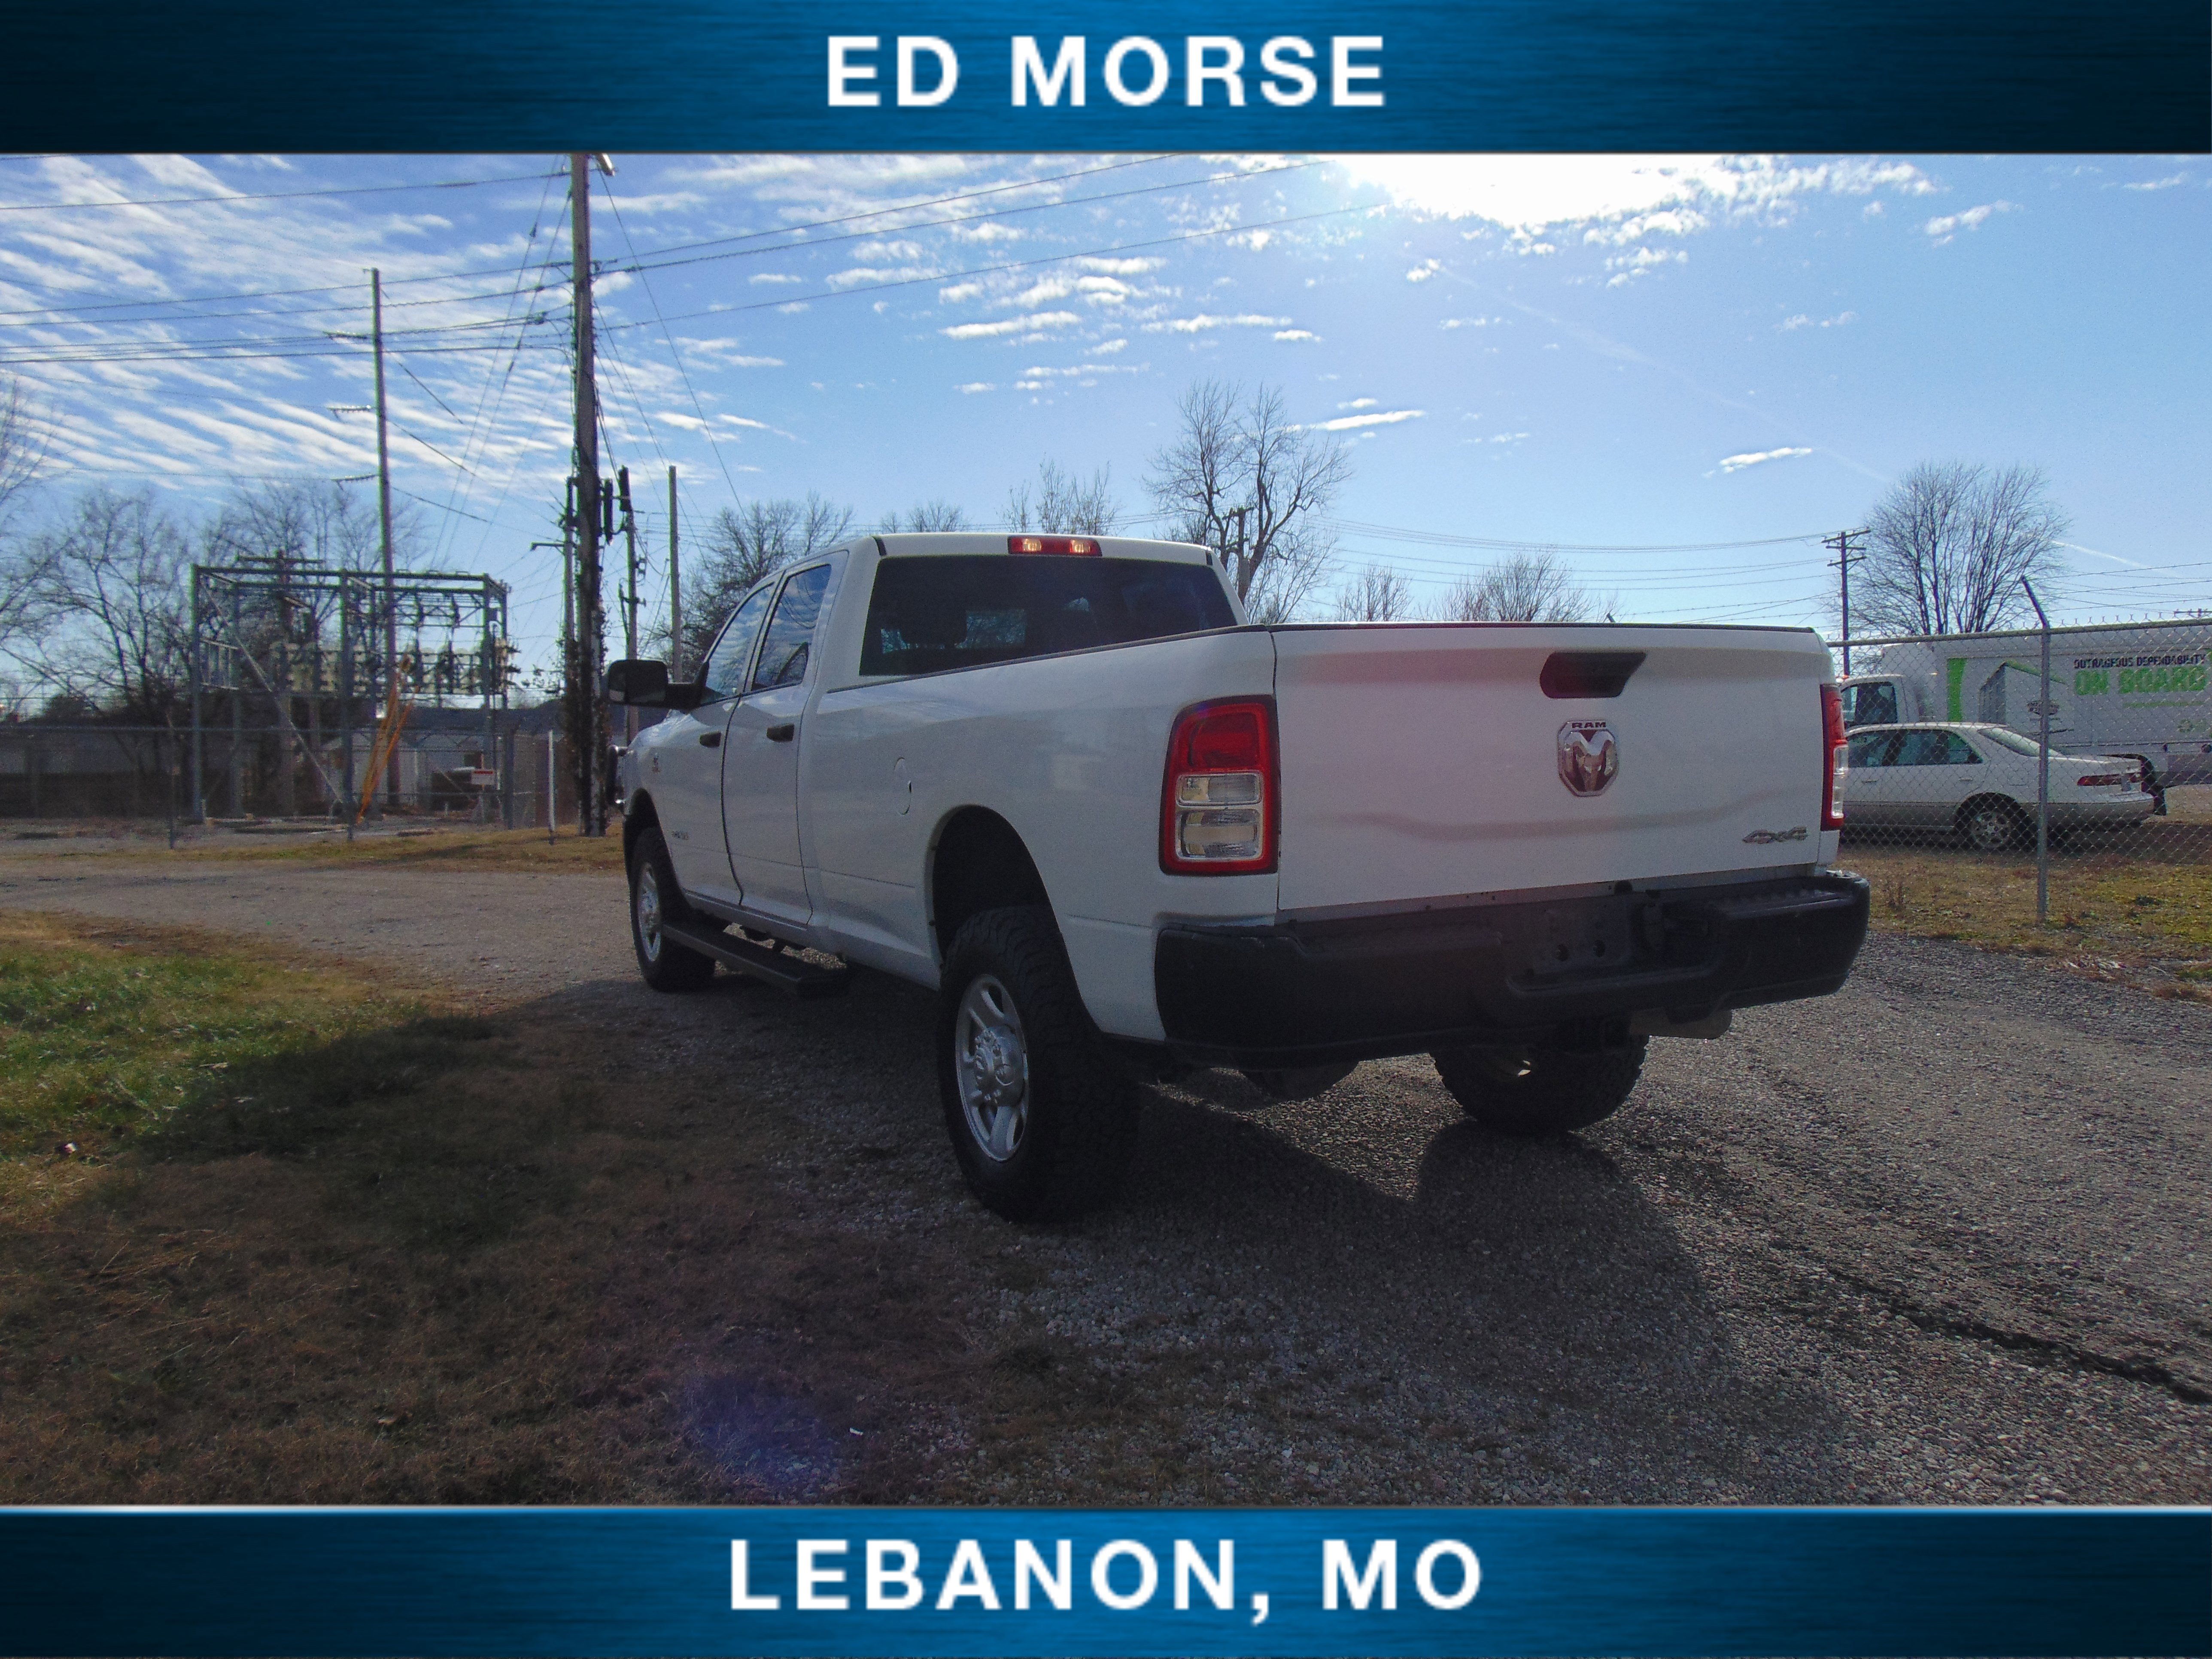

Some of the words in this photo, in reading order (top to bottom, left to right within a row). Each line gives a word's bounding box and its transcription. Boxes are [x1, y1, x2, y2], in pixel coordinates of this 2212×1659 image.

[2074, 657, 2133, 668] OUTRAGEOUS
[2136, 654, 2206, 666] DEPENDABILITY
[2075, 669, 2110, 695] ON
[2119, 666, 2206, 694] BOARD
